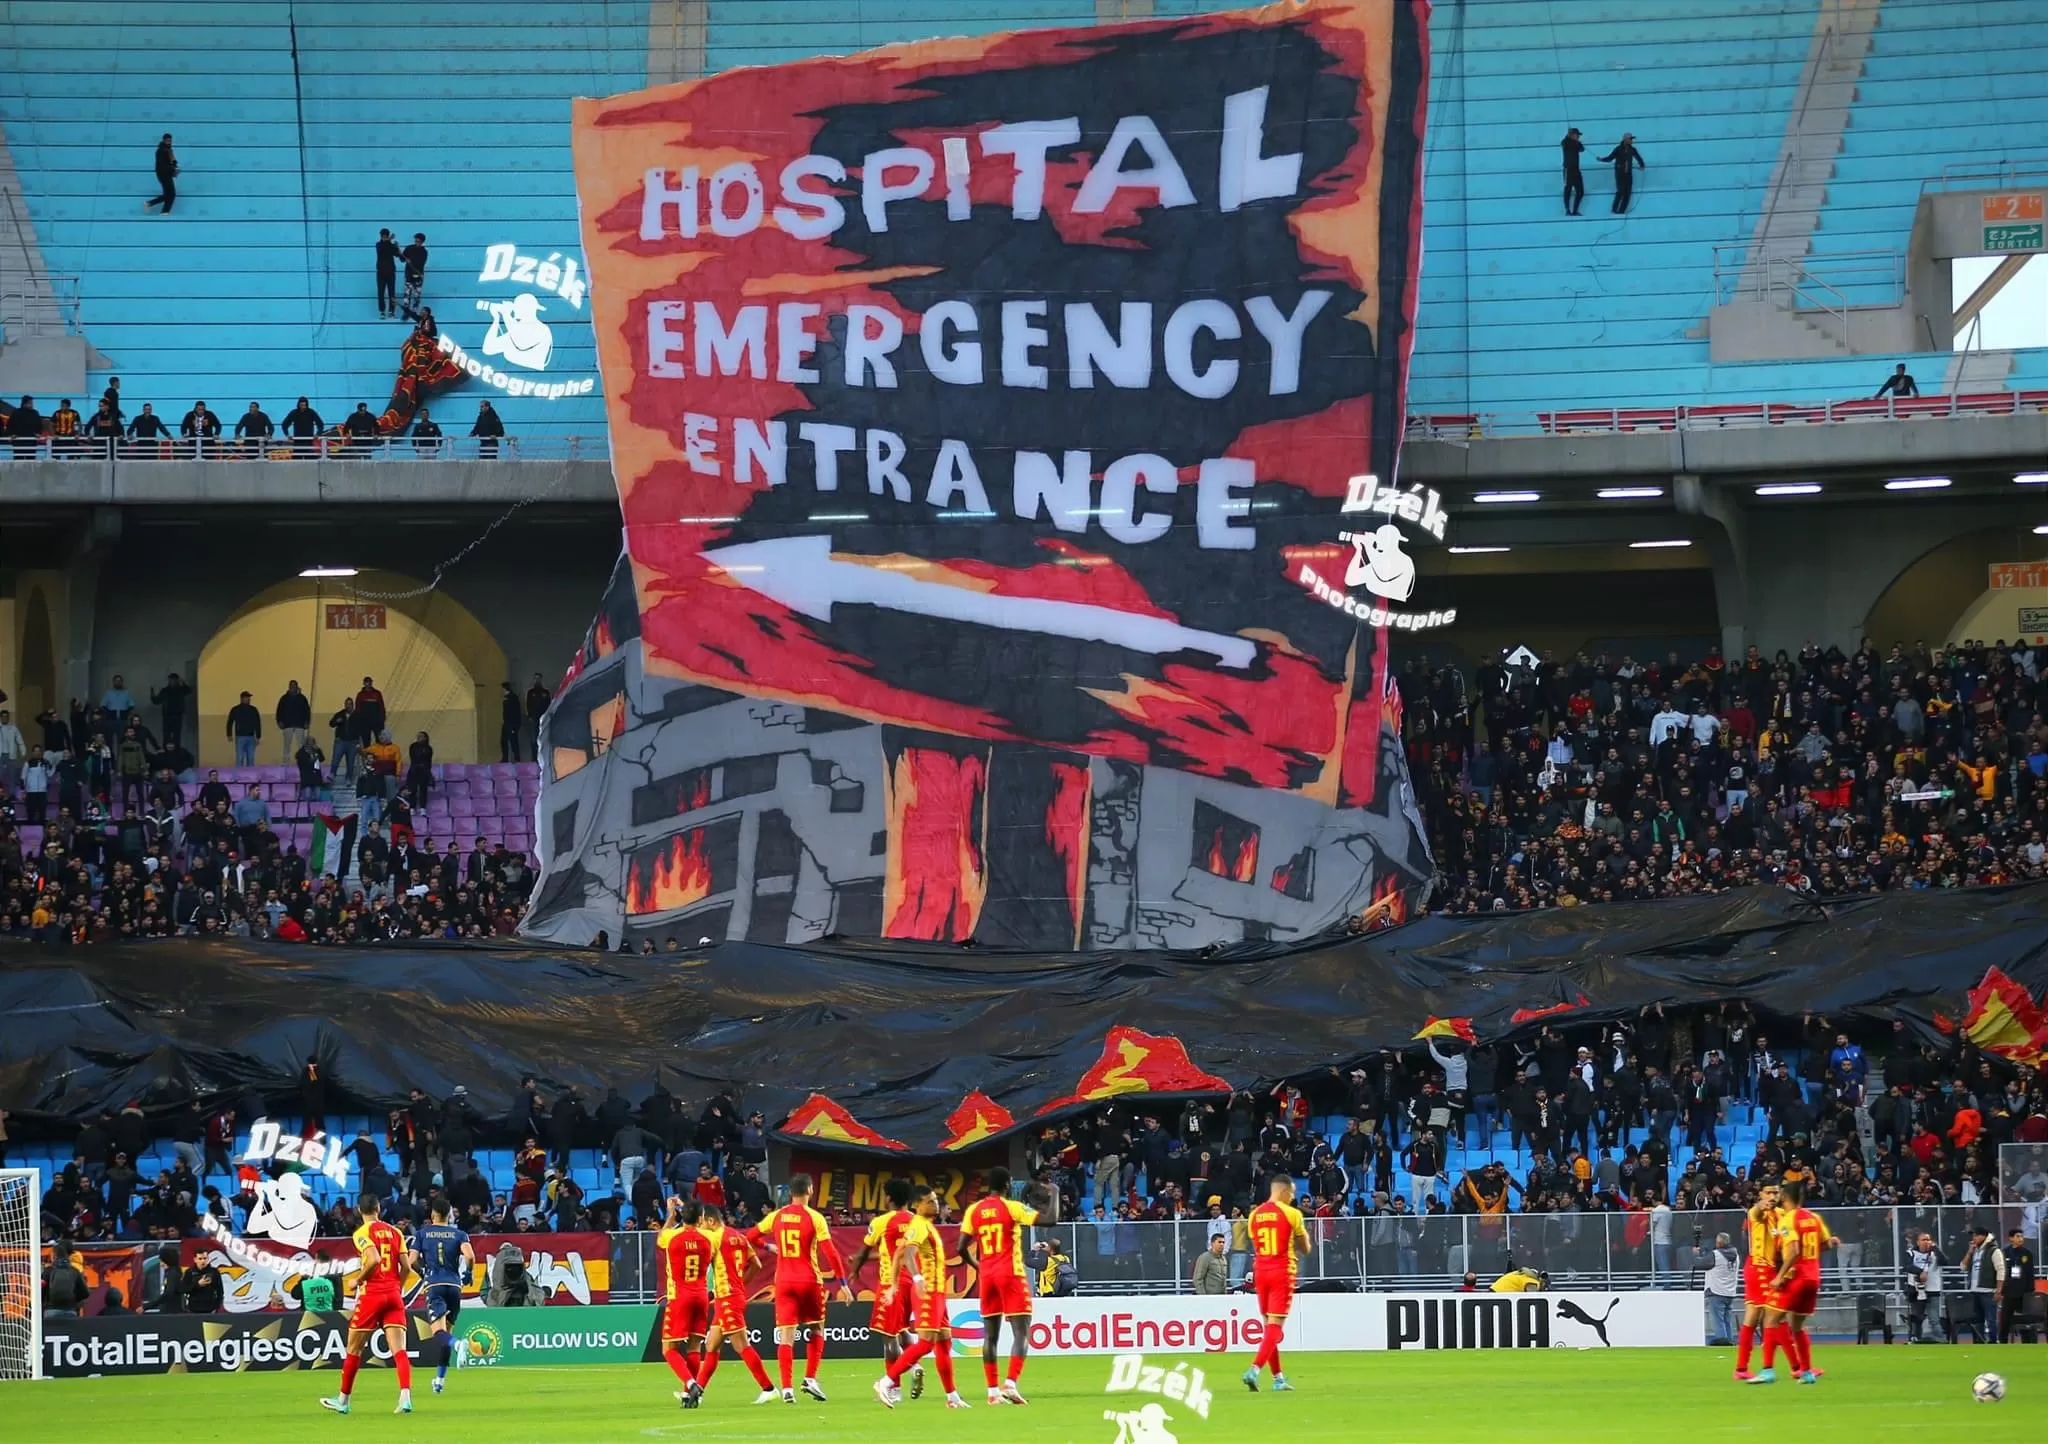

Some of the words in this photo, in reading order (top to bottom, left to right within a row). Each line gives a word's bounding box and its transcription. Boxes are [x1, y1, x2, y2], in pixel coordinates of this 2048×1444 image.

[639, 85, 1303, 241] HOSPITAL
[647, 290, 1334, 399] EMERGENCY
[682, 411, 1256, 549] ENTRANCE
[333, 614, 350, 628] 14
[362, 614, 378, 628] 13
[437, 1240, 444, 1265] 1
[781, 1229, 800, 1258] 15
[979, 1223, 1003, 1255] 27
[1257, 1227, 1278, 1256] 31
[380, 1243, 392, 1273] 5
[685, 1254, 699, 1282] 8
[1012, 1308, 1284, 1353] otalEnergie
[1387, 1299, 1550, 1350] PUMA
[512, 1333, 582, 1350] FOLLOW
[586, 1332, 608, 1348] US
[612, 1331, 638, 1347] ON
[469, 1357, 496, 1366] CAF
